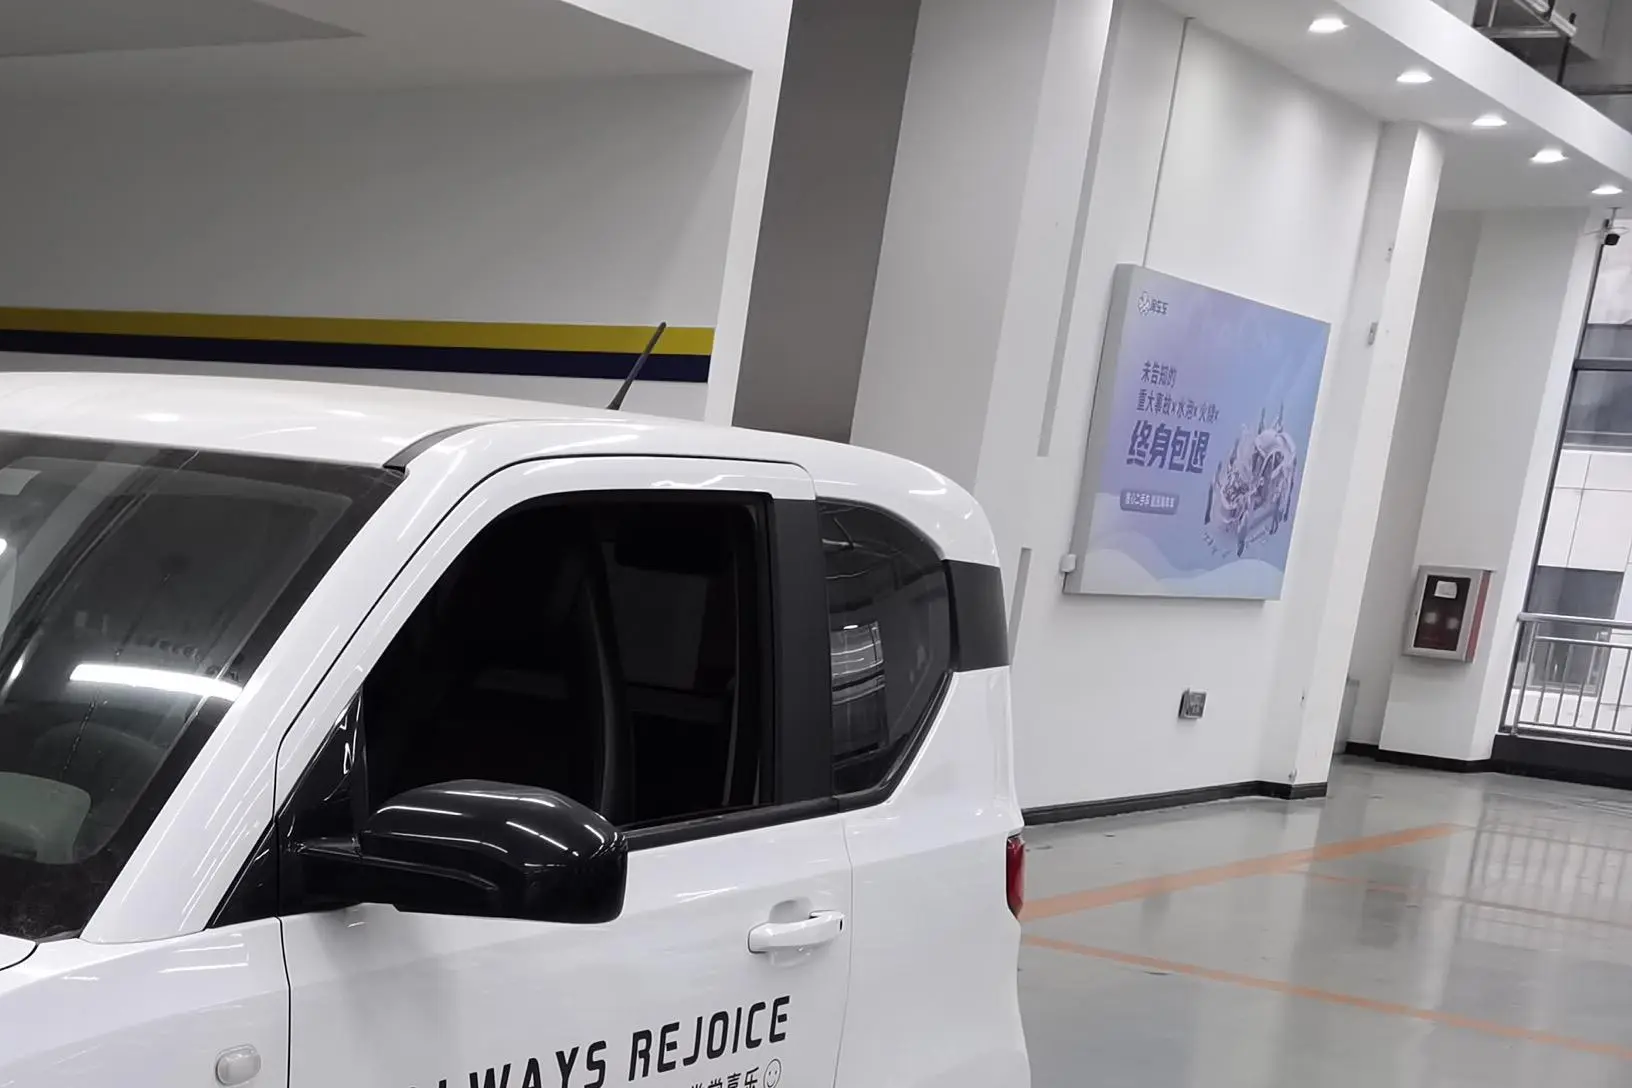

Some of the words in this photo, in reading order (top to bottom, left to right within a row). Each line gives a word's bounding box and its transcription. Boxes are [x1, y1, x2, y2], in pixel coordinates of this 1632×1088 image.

[1126, 420, 1210, 474] 终身包退
[628, 995, 790, 1081] REJOICE
